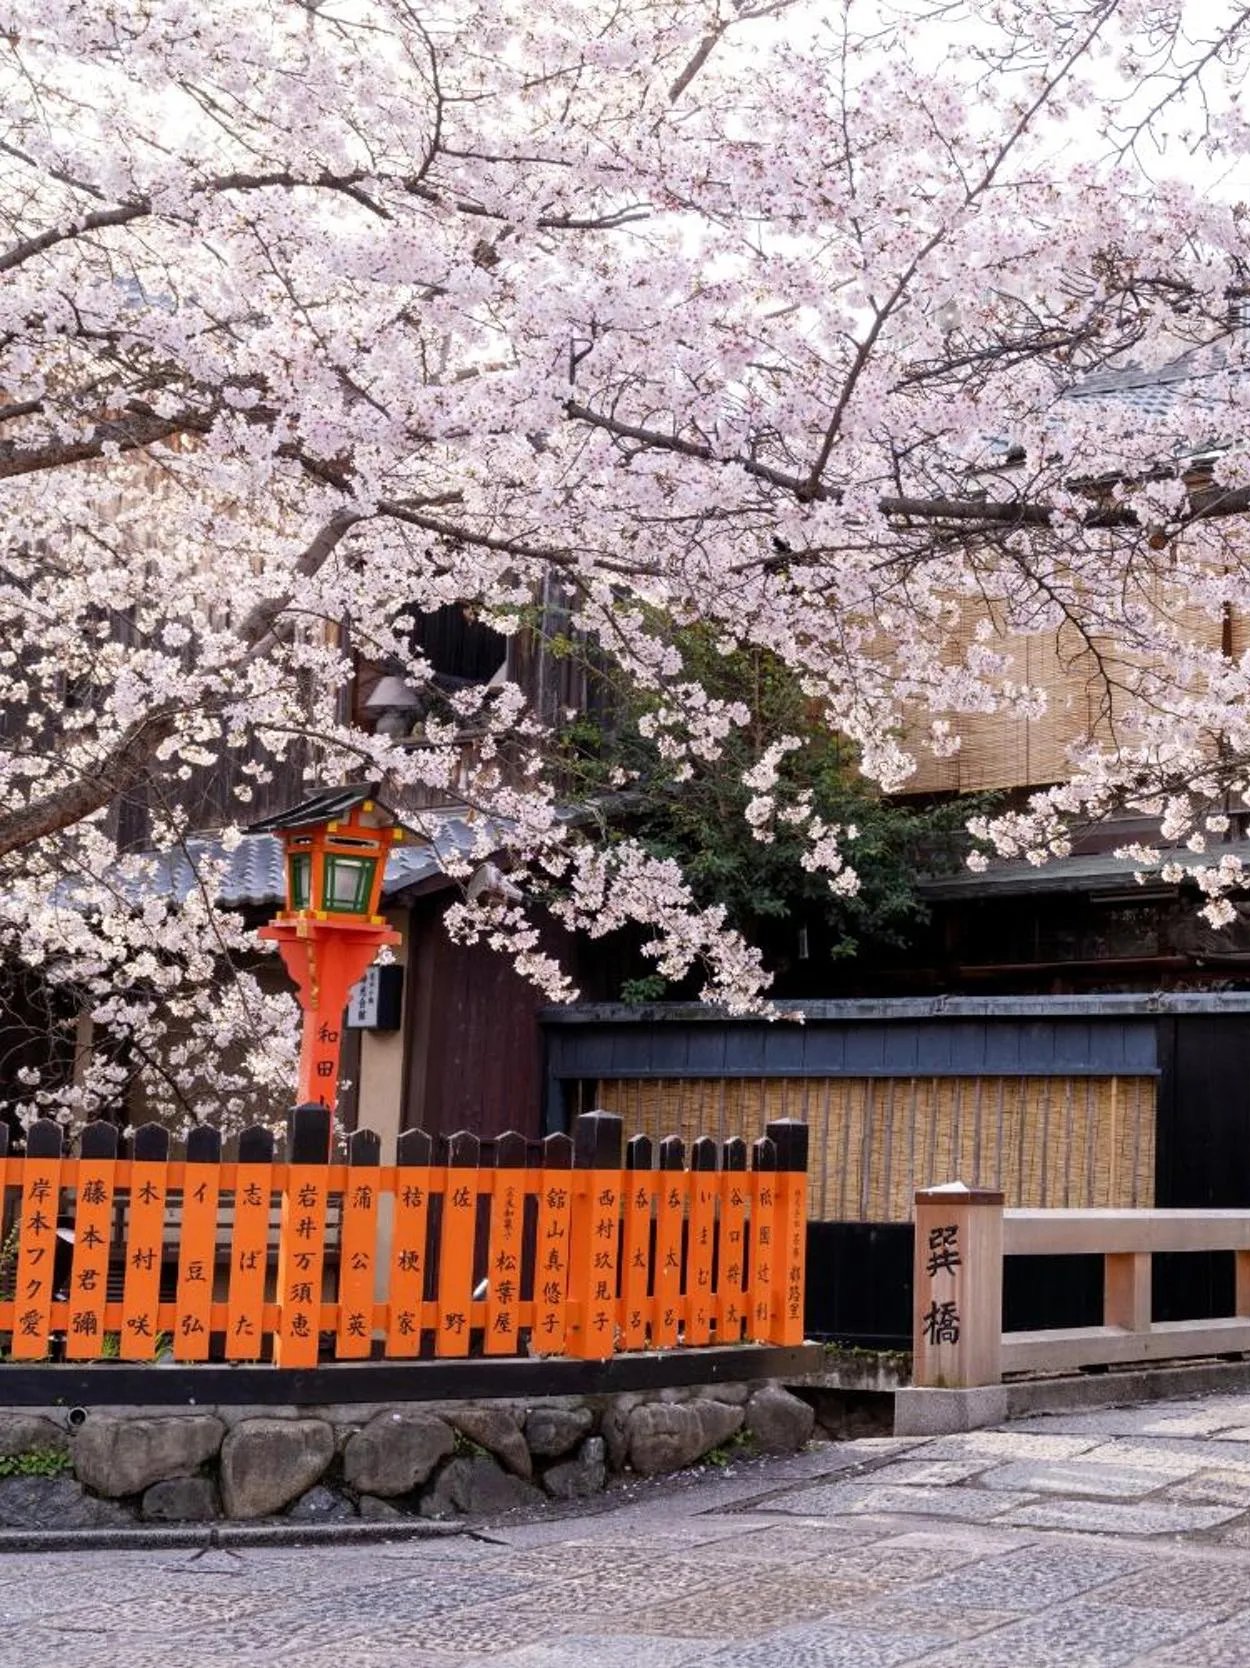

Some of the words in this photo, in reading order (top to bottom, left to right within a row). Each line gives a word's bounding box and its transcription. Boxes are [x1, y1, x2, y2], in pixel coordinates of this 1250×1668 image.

[20, 1178, 52, 1337] 岸本フク愛
[127, 1181, 160, 1337] 木村咲
[236, 1182, 262, 1336] 志ばた
[290, 1183, 318, 1337] 岩井万須恵
[347, 1185, 372, 1337] 蒲公英
[398, 1185, 424, 1335] 桔梗家
[445, 1186, 472, 1334] 佐野
[493, 1250, 516, 1333] 松葉屋
[923, 1224, 962, 1345] 巽橋
